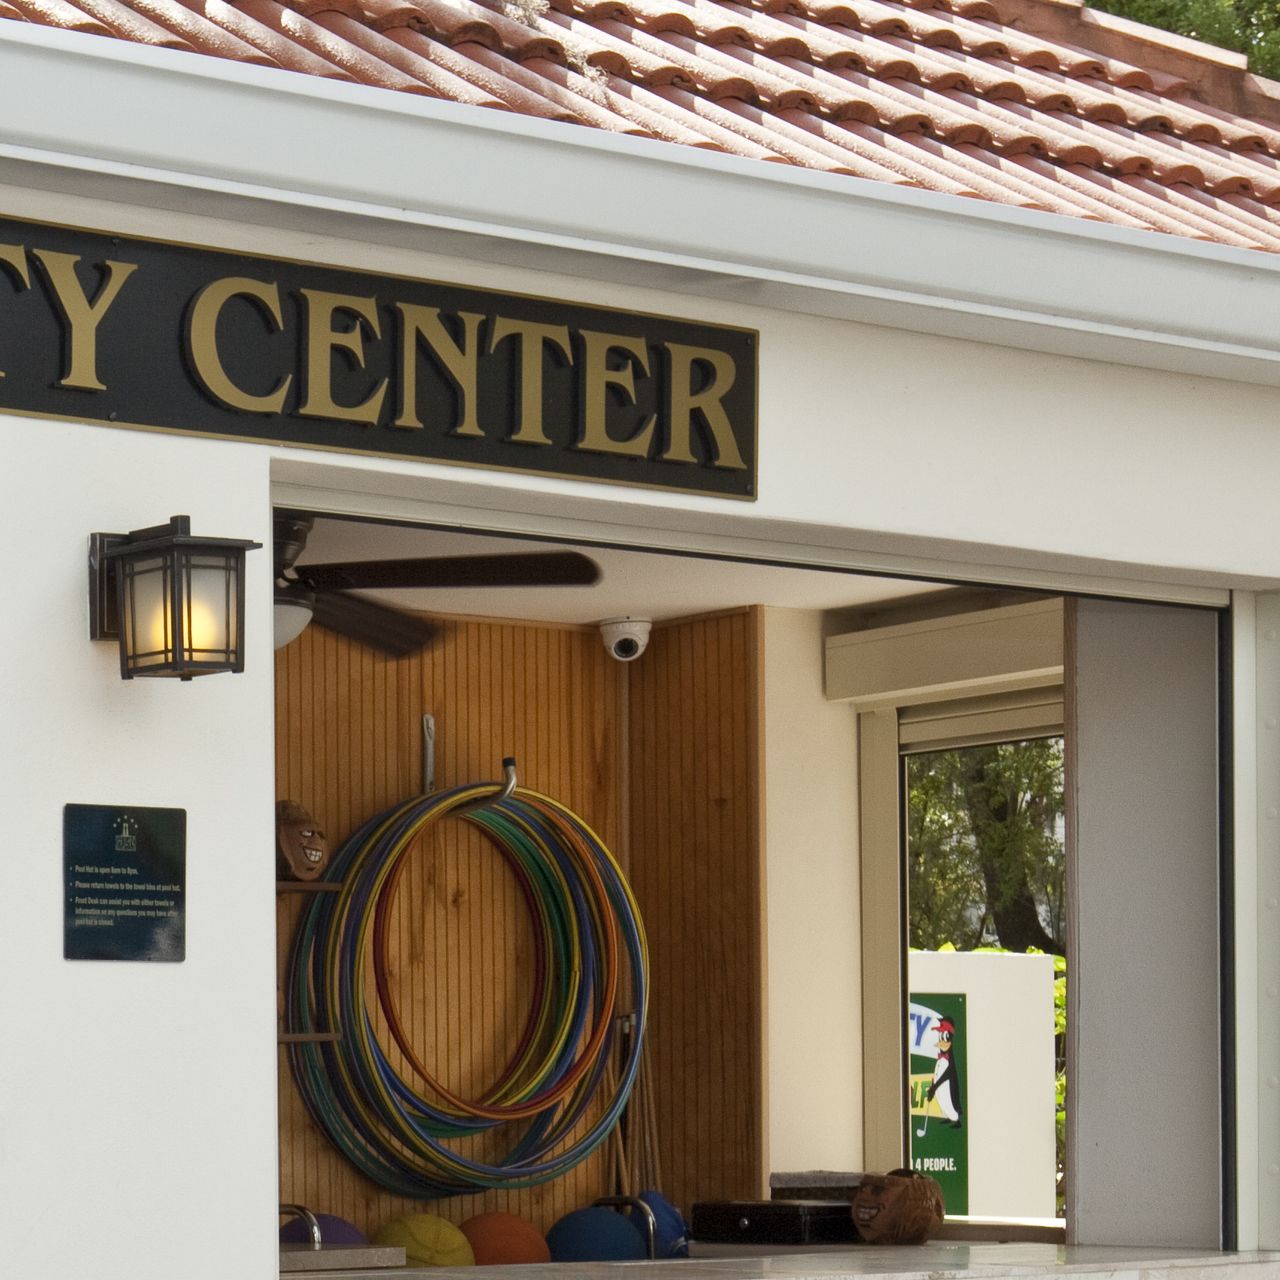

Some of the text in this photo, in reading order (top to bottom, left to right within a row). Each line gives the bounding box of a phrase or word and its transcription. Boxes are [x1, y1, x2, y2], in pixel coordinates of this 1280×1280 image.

[184, 276, 747, 470] CENTER
[915, 1158, 957, 1171] 4 PEOPLE.
